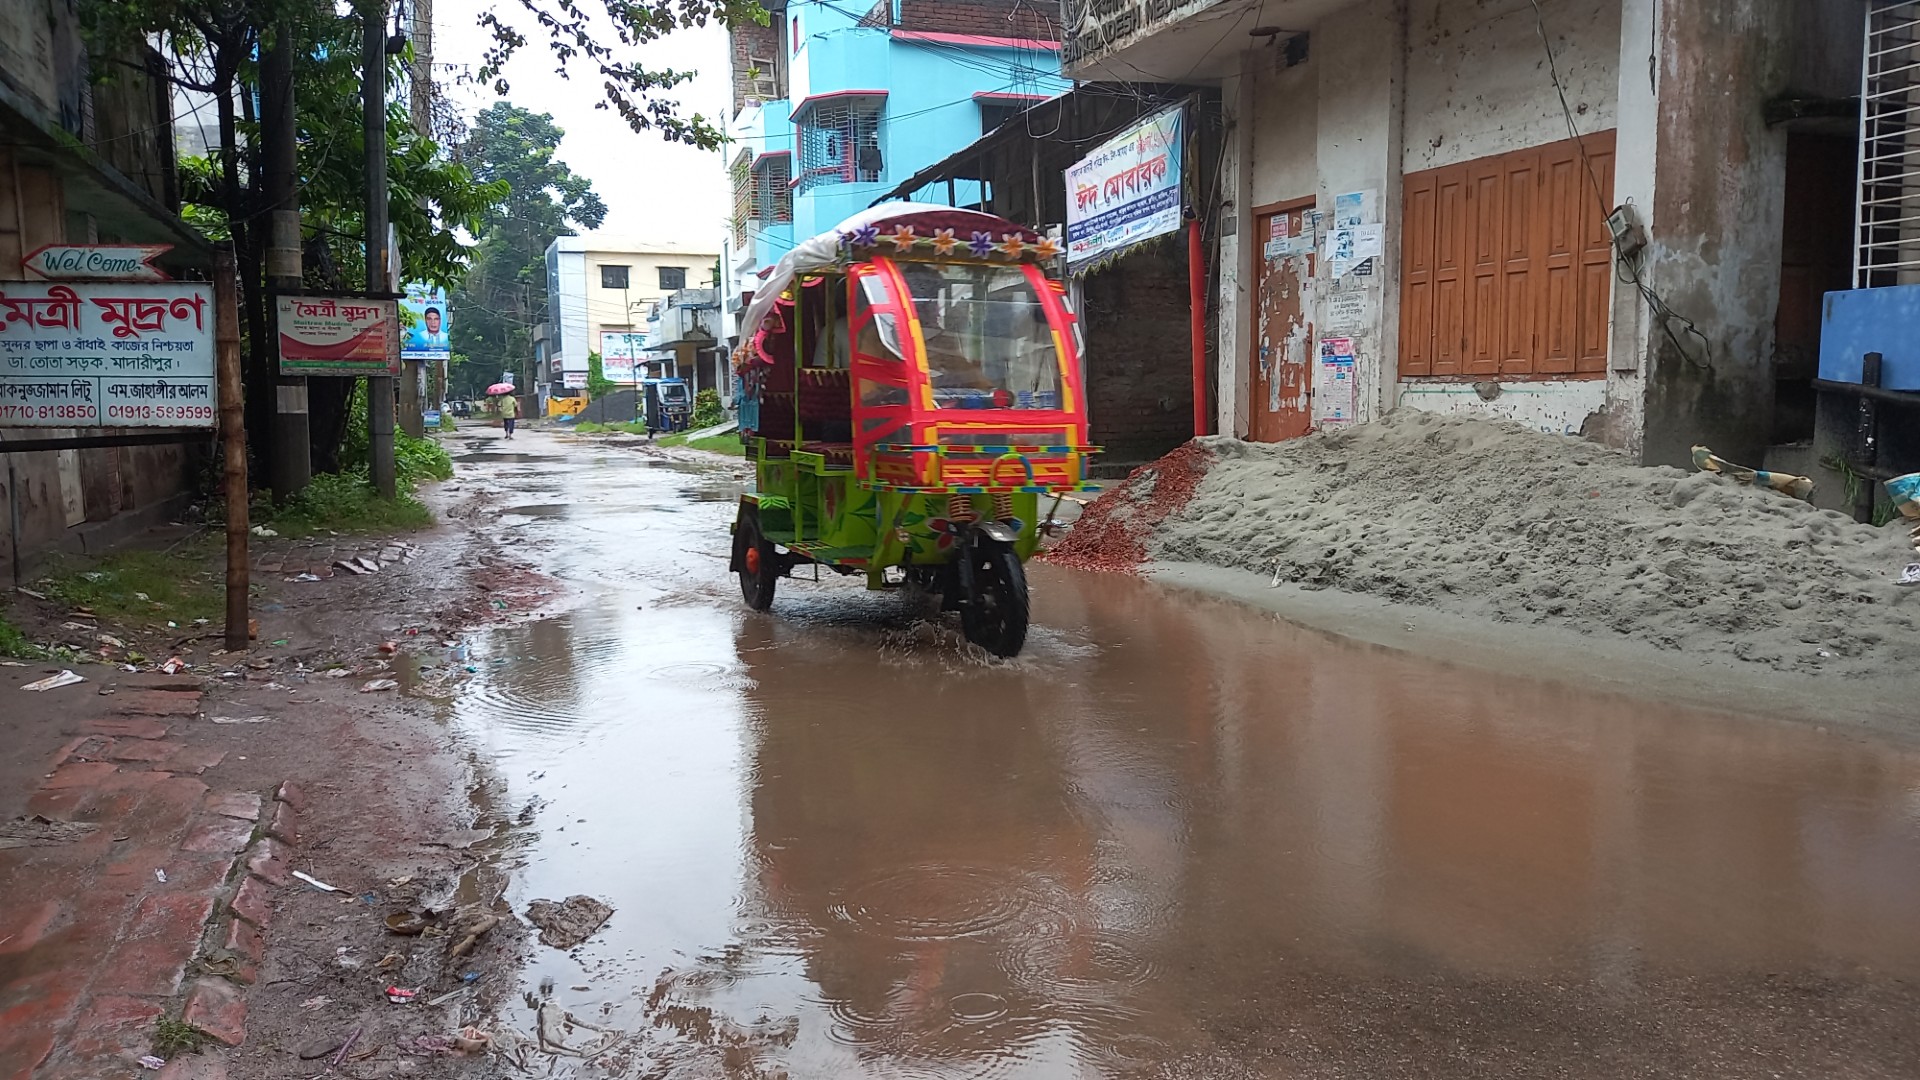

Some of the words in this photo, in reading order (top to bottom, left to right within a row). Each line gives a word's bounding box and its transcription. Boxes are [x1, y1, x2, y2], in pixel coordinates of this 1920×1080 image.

[1075, 184, 1098, 213] ঈদ
[1104, 154, 1167, 207] মোবারক
[89, 292, 207, 339] মুদ্রণ
[291, 300, 337, 317] মৈত্রী
[340, 306, 380, 322] মুদ্রণ
[1, 340, 31, 353] সুন্দর
[35, 340, 58, 351] ছাপা
[61, 340, 71, 350] ও
[74, 337, 106, 350] বাঁধাই
[111, 340, 149, 351] কাজের
[151, 338, 194, 352] নিশ্চয়তা
[8, 356, 27, 369] ডা.
[29, 356, 63, 369] তোতা
[71, 379, 93, 403] লিটু
[178, 383, 208, 399] আলম
[0, 405, 96, 419] 1710-813850
